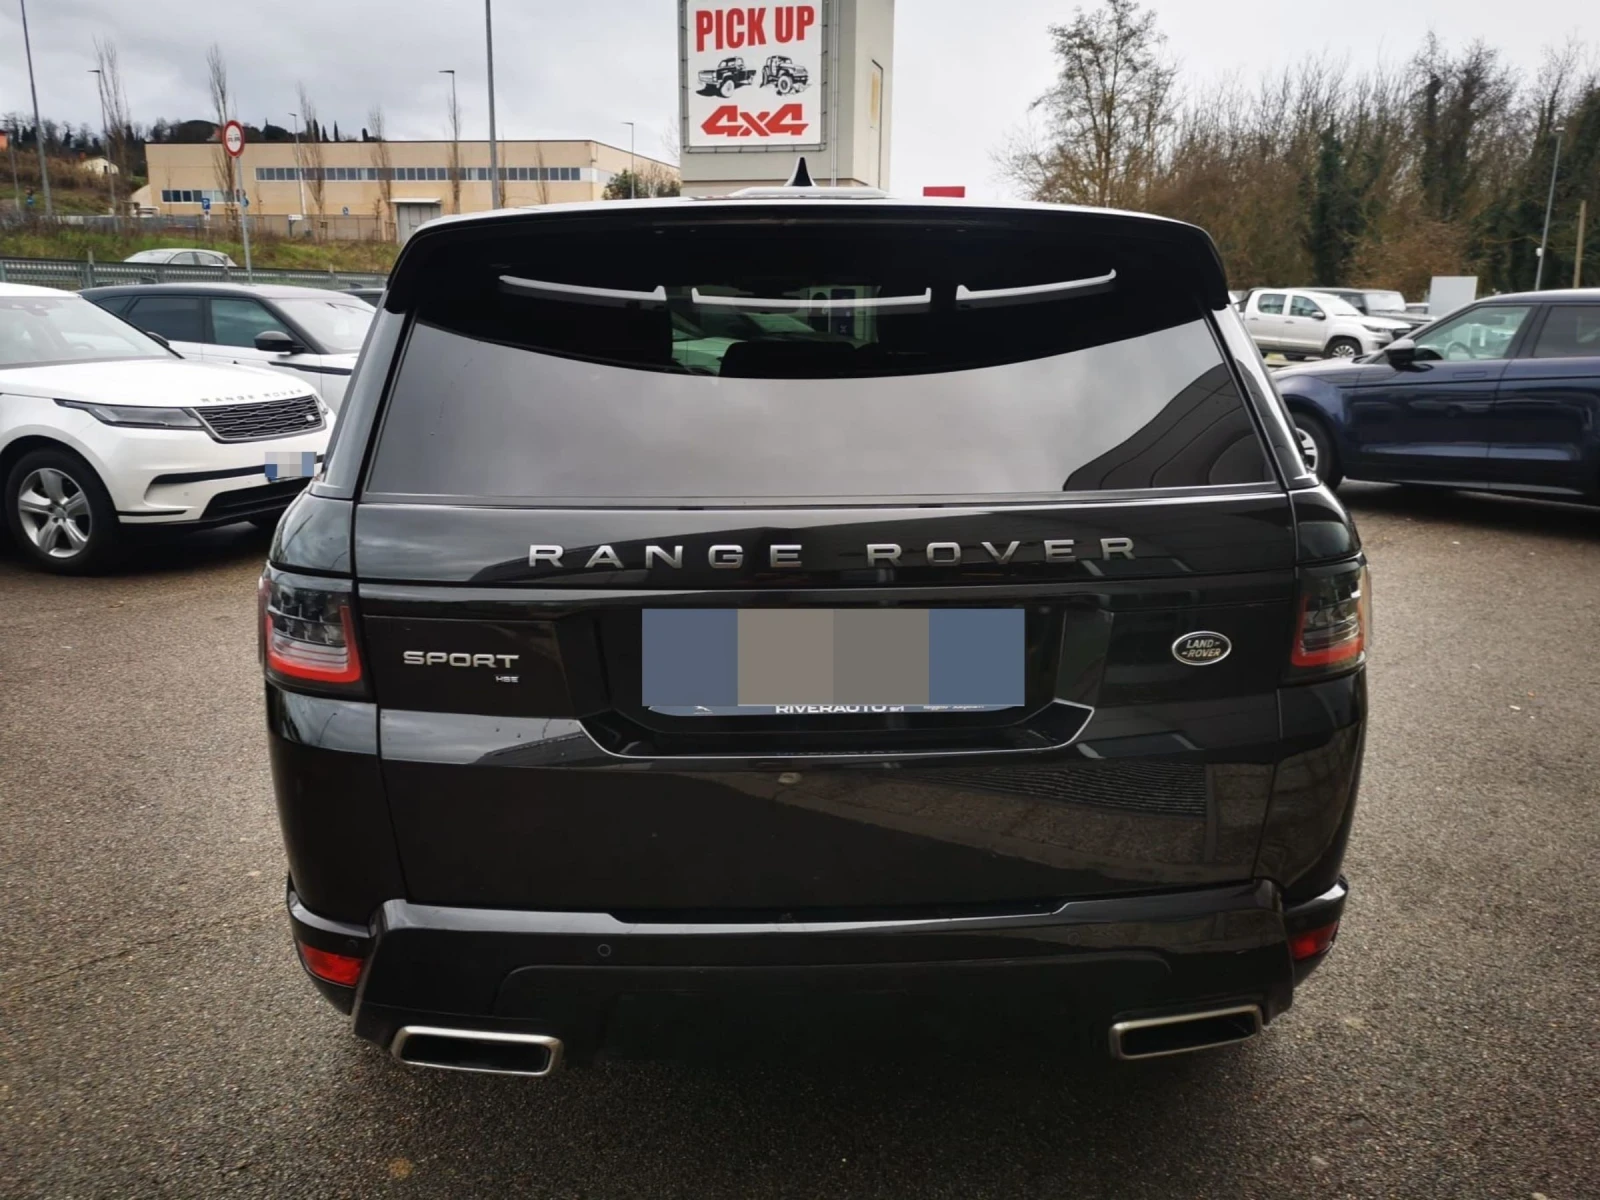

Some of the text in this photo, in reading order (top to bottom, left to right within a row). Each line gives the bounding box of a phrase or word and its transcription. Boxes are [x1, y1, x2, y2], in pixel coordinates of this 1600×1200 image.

[695, 5, 815, 52] PICK UP
[701, 103, 809, 137] 4x4
[528, 537, 1136, 569] RANGE ROVER
[403, 650, 520, 669] SPORT
[495, 675, 519, 683] HSE
